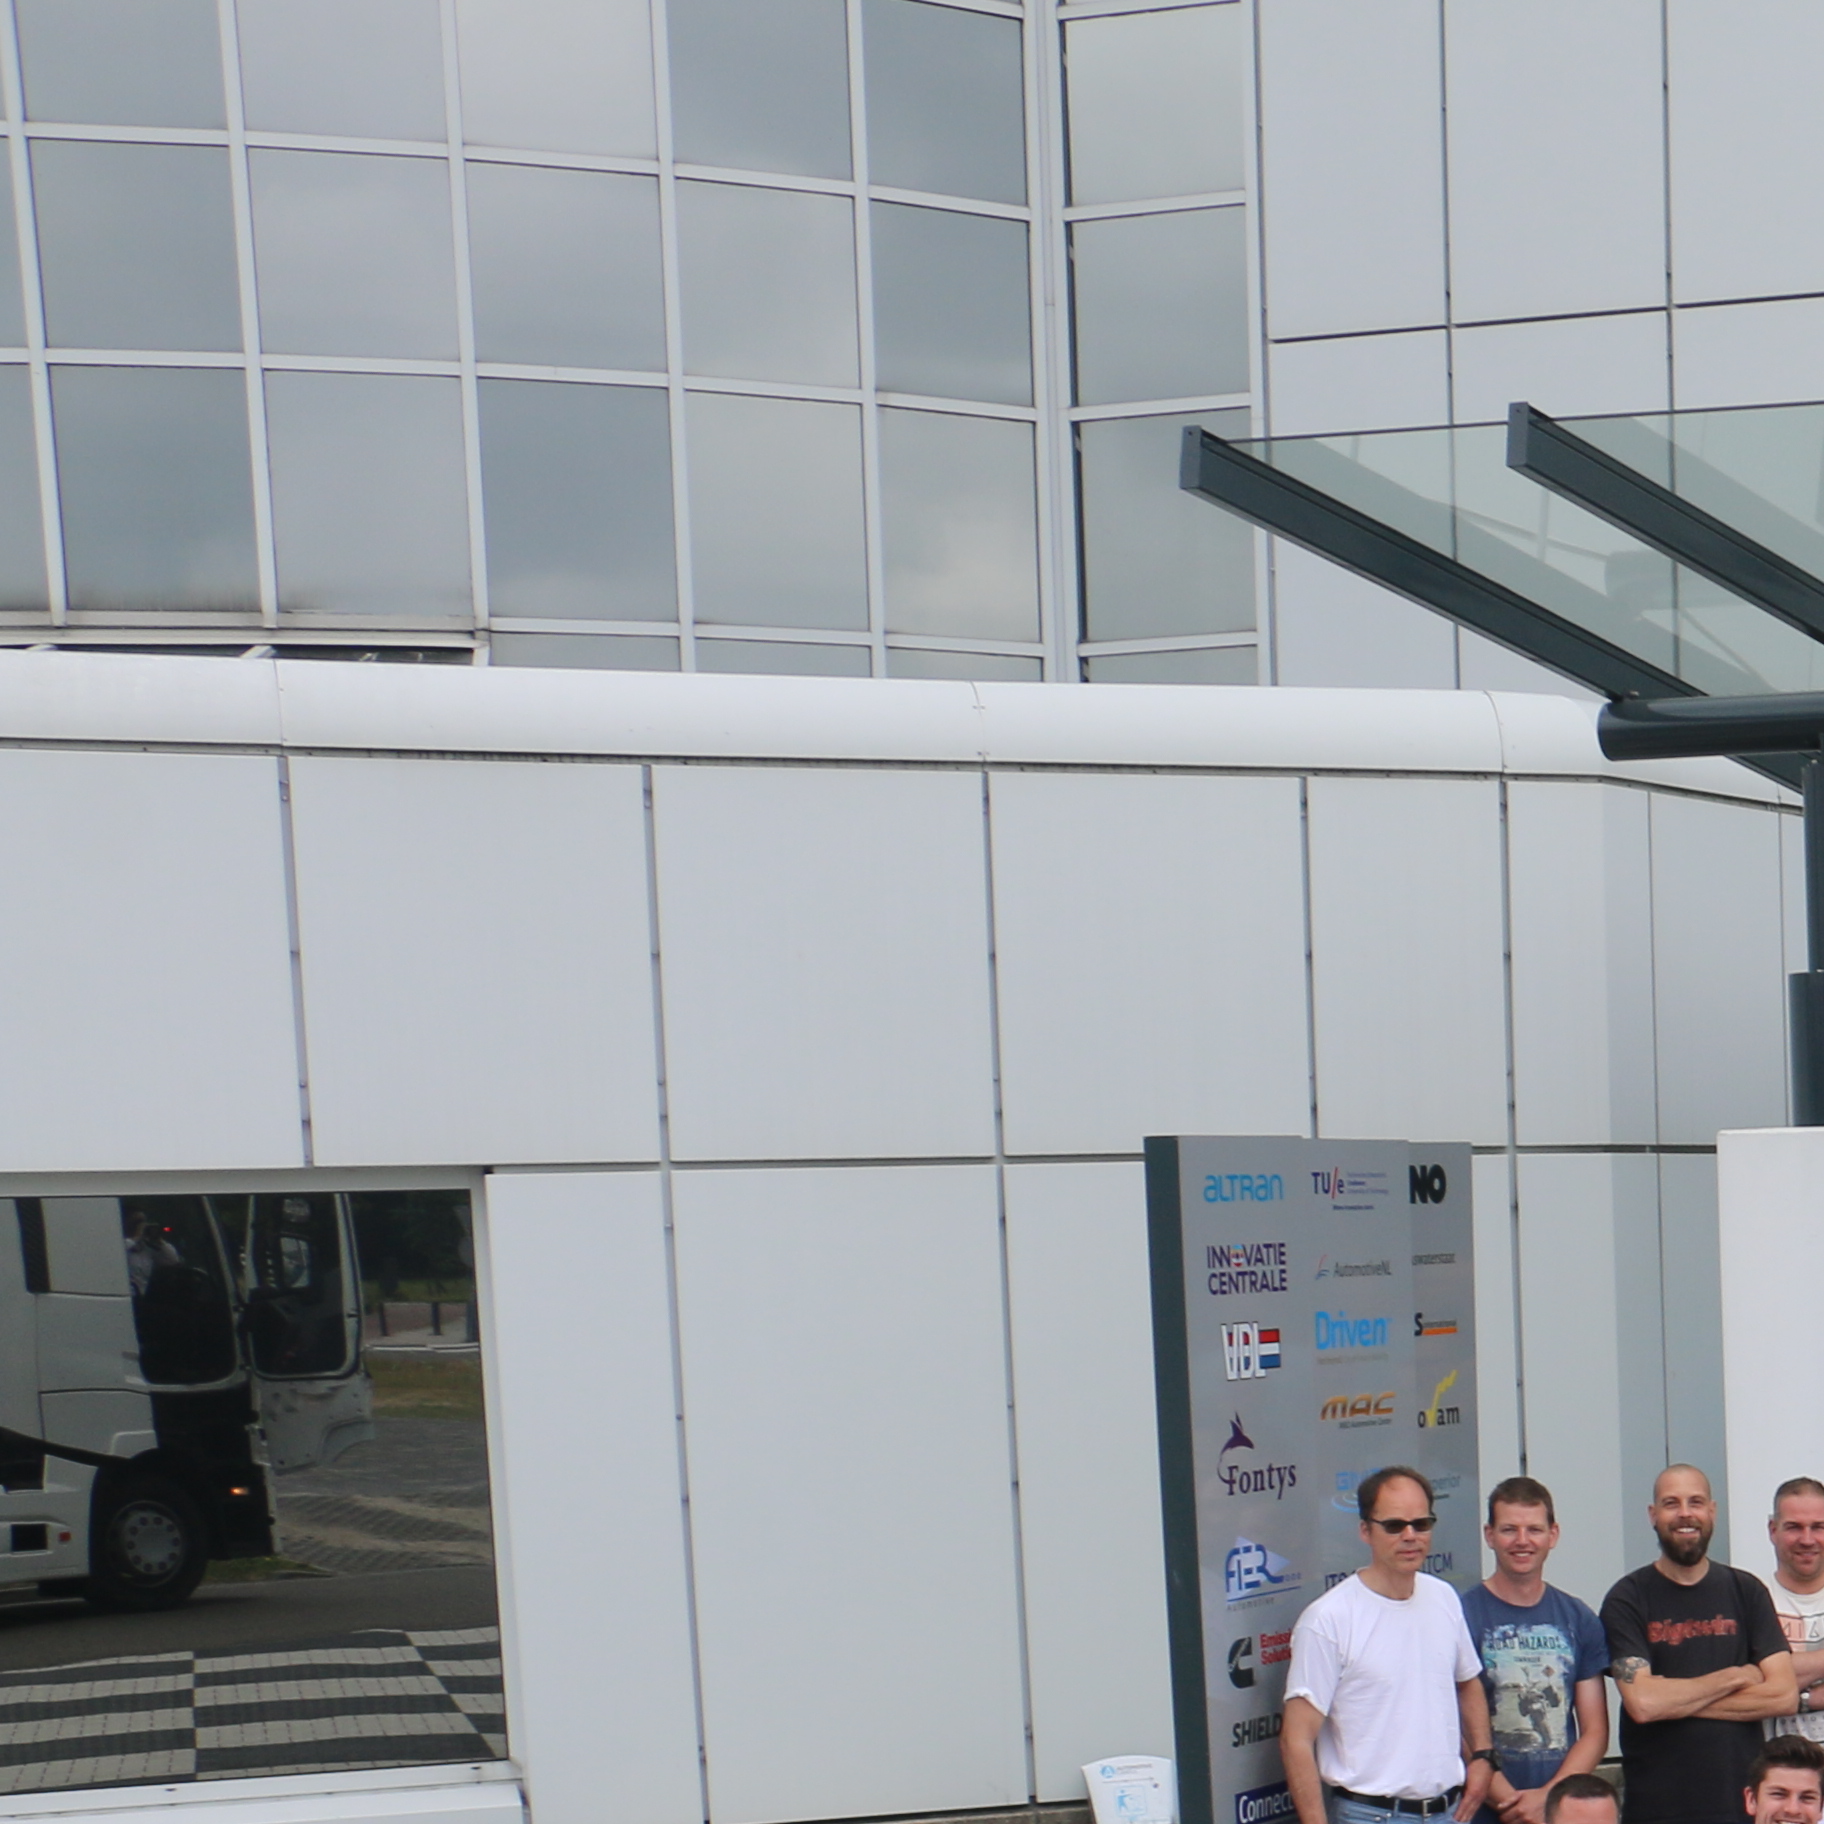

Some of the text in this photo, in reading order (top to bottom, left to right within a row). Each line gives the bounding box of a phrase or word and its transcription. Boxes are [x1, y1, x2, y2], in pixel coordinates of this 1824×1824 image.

[1208, 1269, 1288, 1295] CENTRALE
[1315, 1310, 1389, 1350] Driven
[1221, 1321, 1267, 1381] VDL
[1226, 1463, 1297, 1500] Fontys
